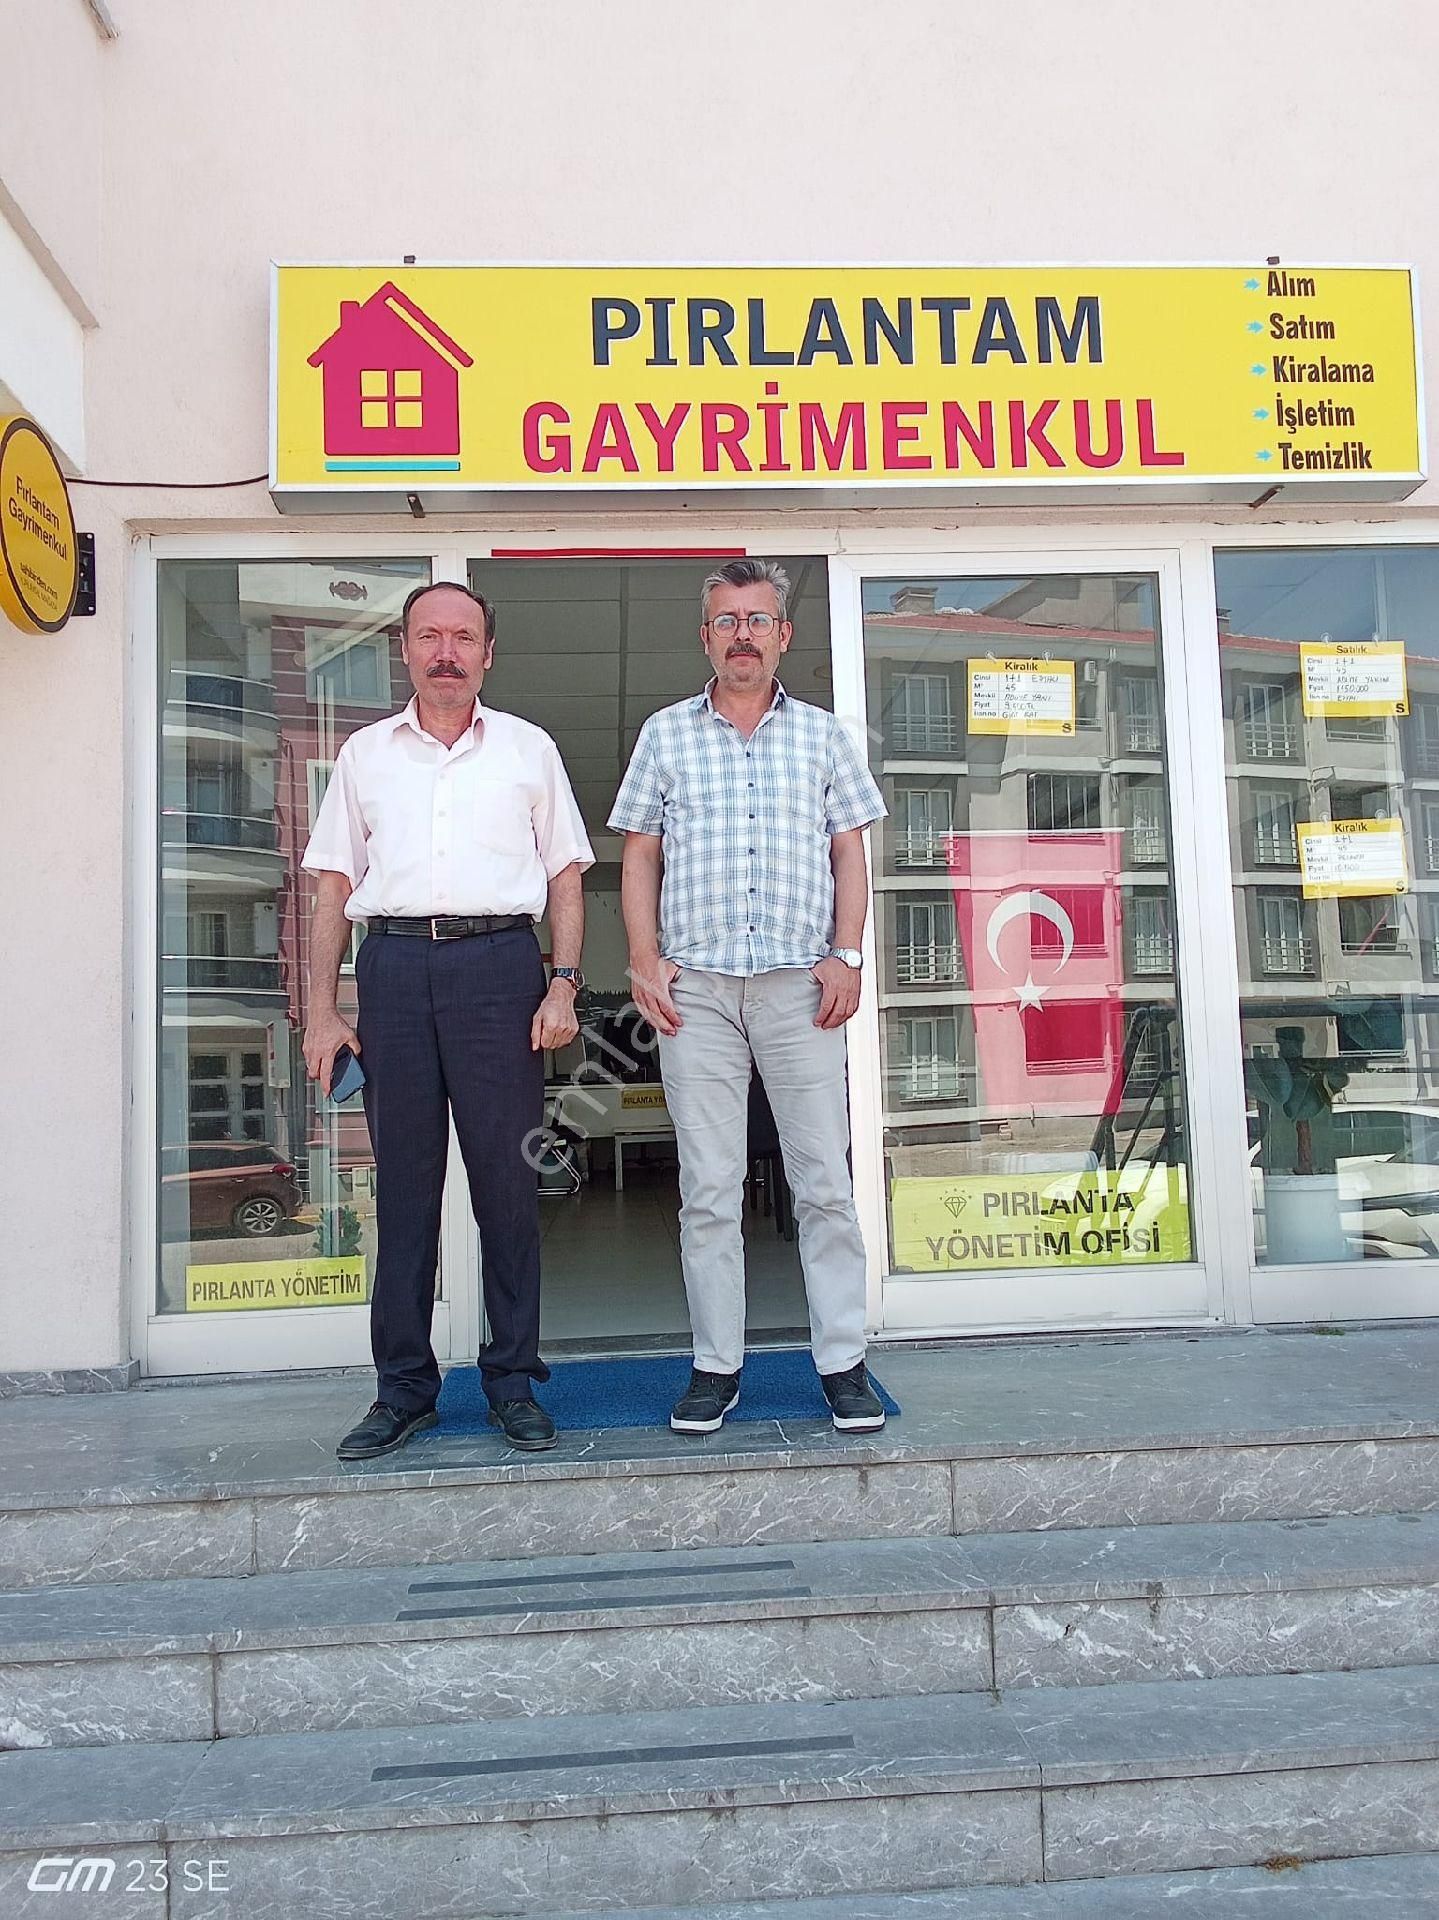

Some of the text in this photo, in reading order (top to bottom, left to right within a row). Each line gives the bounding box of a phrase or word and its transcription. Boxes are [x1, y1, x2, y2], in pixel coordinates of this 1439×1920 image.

[1267, 271, 1316, 296] Alım
[592, 297, 1103, 366] PIRLANTAM
[1269, 313, 1335, 339] Satım
[1273, 356, 1374, 382] Kiralama
[1276, 393, 1355, 434] İşletim
[523, 382, 1185, 473] GAYRİMENKUL
[1278, 442, 1373, 469] Temizlik
[8, 497, 68, 561] Gayrimenkul
[1336, 645, 1368, 654] Satılık
[1005, 661, 1039, 671] Kiralık
[1396, 703, 1405, 713] S
[1334, 822, 1368, 833] Kiralık
[983, 1188, 1136, 1217] PIRLANTA
[925, 1221, 1160, 1261] YÖNETİM OFİSİ
[193, 1269, 361, 1301] PIRLANTA YÖNETİM
